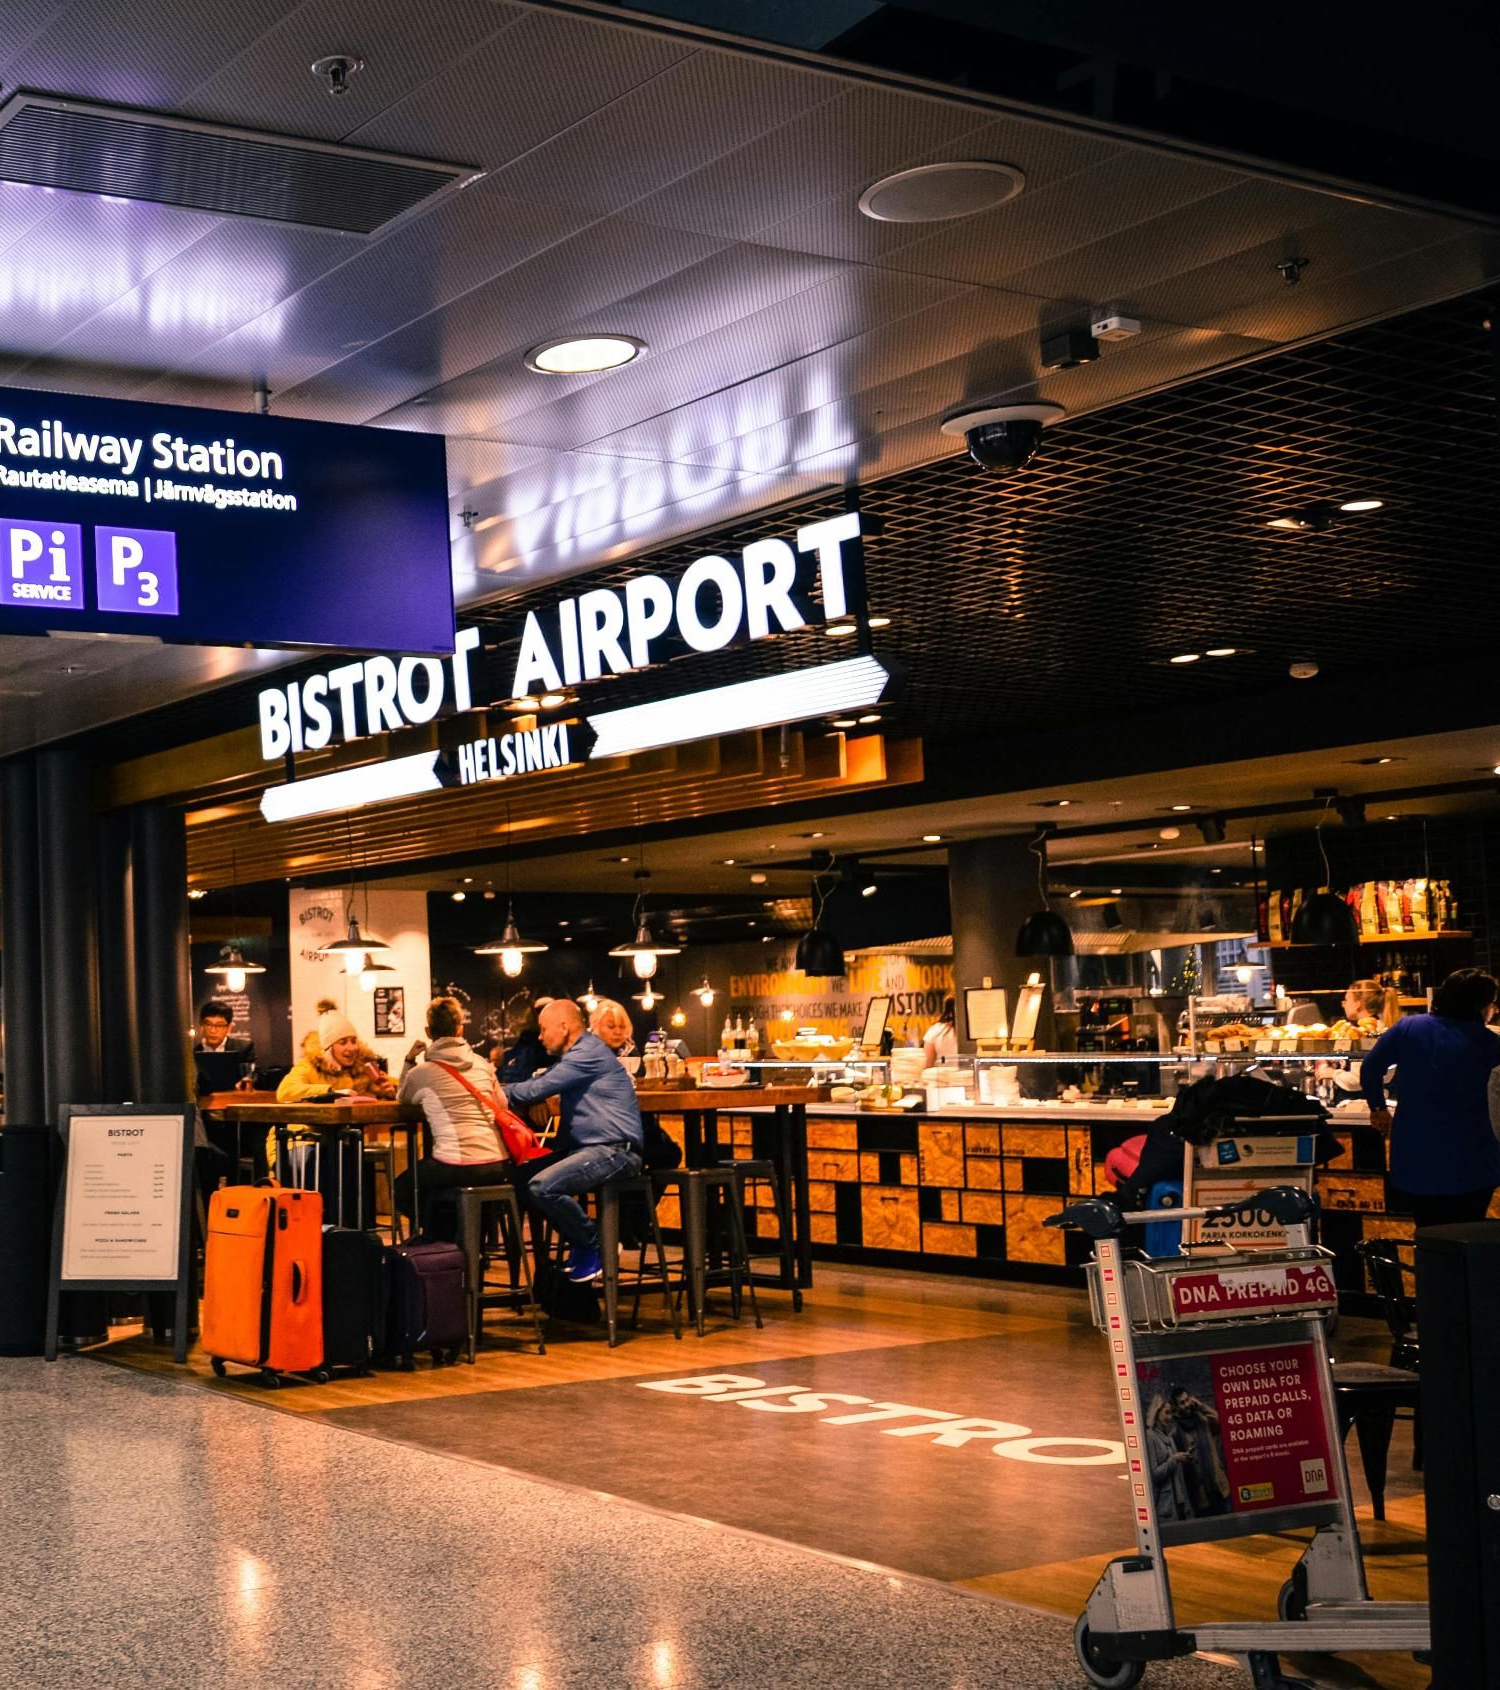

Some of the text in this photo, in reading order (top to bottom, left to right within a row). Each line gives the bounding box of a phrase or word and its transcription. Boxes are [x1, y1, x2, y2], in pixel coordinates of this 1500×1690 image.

[153, 438, 283, 479] Station
[154, 479, 297, 511] Järnvägsstation
[10, 528, 71, 583] Pi
[111, 536, 159, 606] P3
[12, 582, 72, 601] SERVICE
[258, 512, 861, 760] BISTROT AIRPORT
[458, 724, 570, 785] HELSINKI
[299, 906, 334, 925] BISTROT
[885, 975, 905, 991] AND
[787, 1003, 822, 1018] HOICES
[824, 1003, 839, 1018] WE
[840, 1002, 863, 1017] MAKE
[891, 991, 946, 1016] ISTROT
[108, 1128, 145, 1137] BISTROT
[1202, 1208, 1286, 1228] 2500
[1201, 1230, 1287, 1239] PARIA KORKOKENK
[1179, 1275, 1330, 1305] DNA PREPAID 4G
[1220, 1359, 1299, 1377] CHOOSE YOUR
[1222, 1374, 1301, 1394] OWN DNA FOR
[1225, 1389, 1311, 1409] PREPAID CALLS,
[636, 1373, 1129, 1478] BISTRO
[1228, 1408, 1293, 1425] 4G DATA OR
[1230, 1425, 1283, 1441] ROAMING
[1304, 1468, 1324, 1483] DNA
